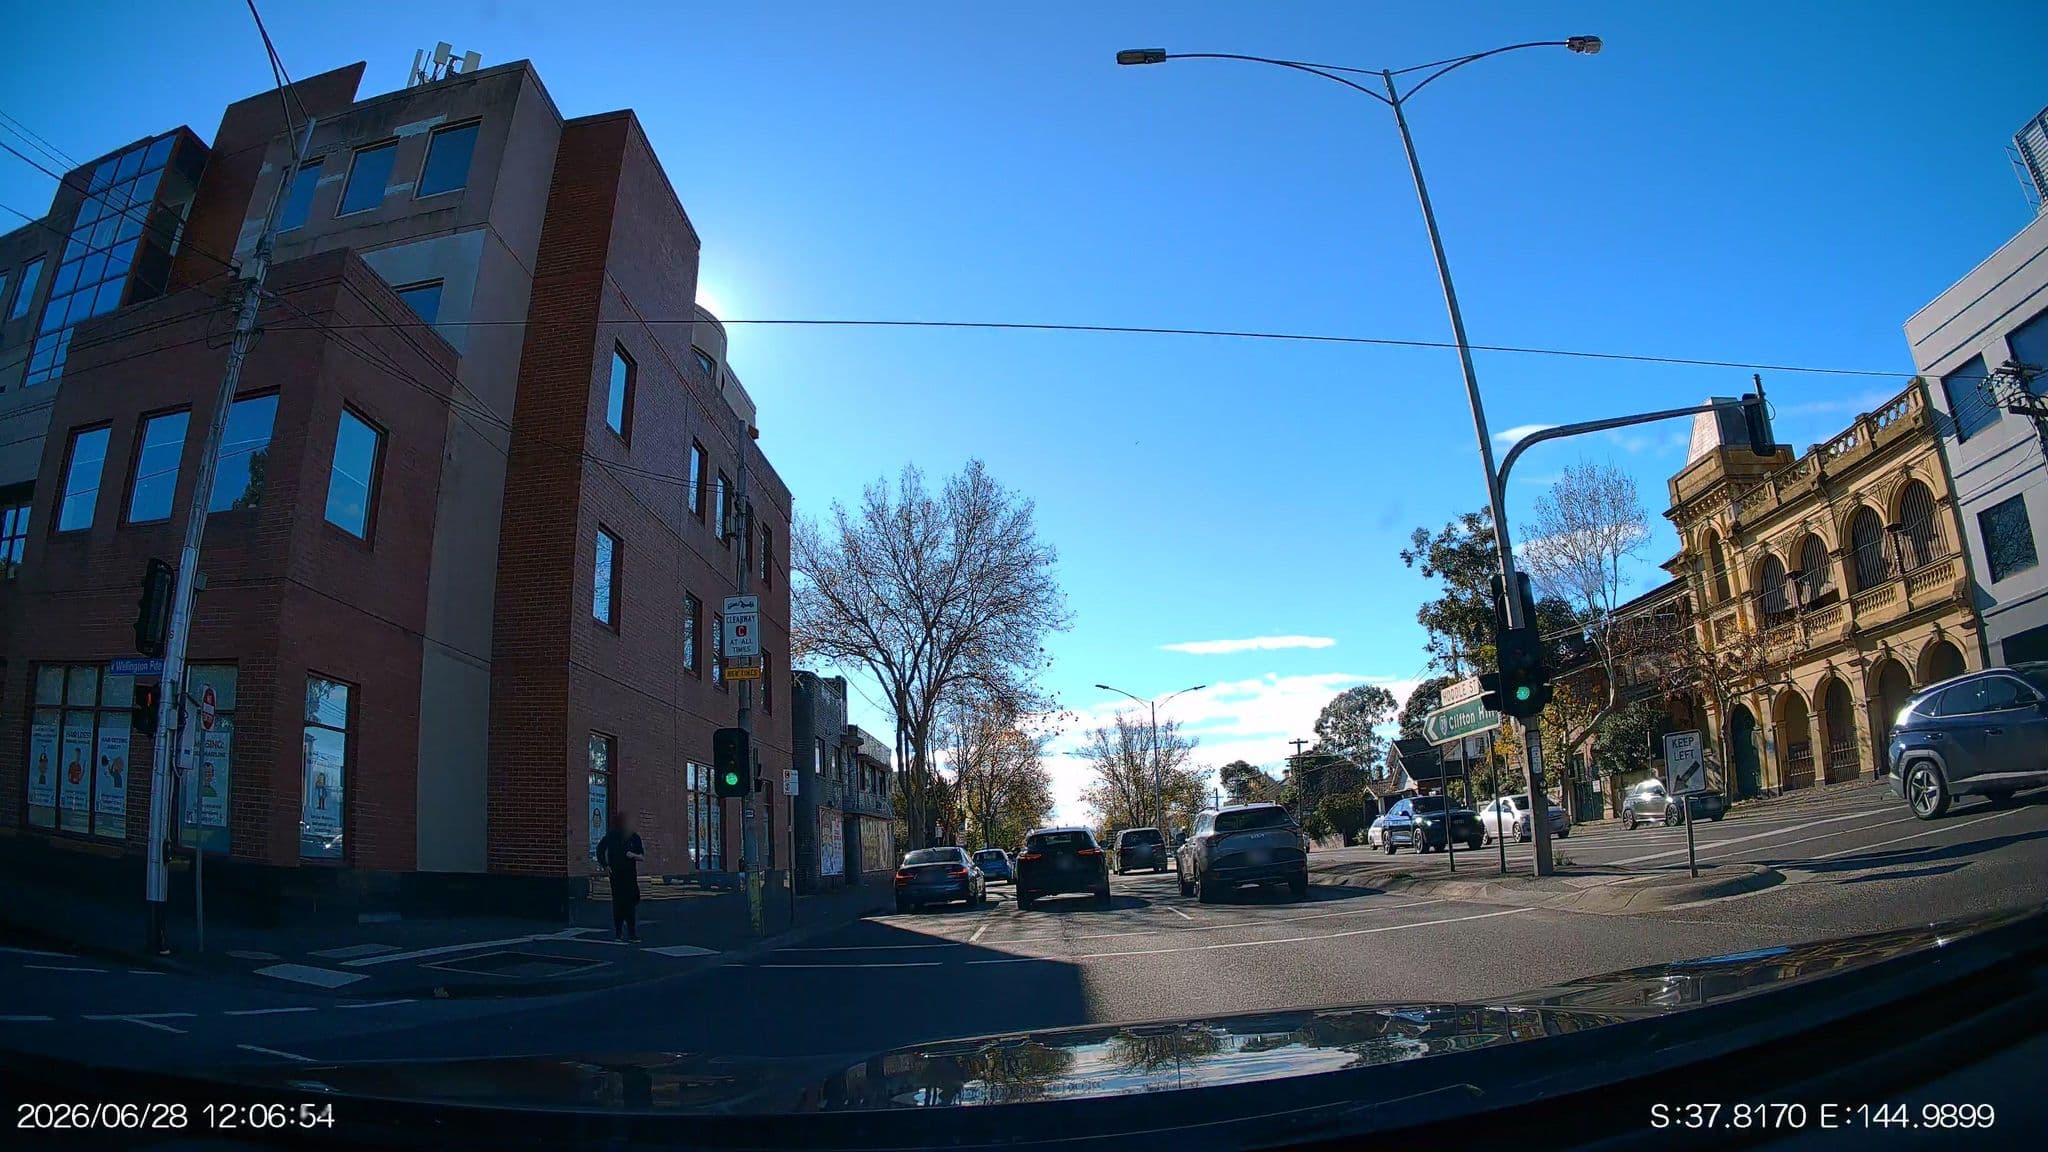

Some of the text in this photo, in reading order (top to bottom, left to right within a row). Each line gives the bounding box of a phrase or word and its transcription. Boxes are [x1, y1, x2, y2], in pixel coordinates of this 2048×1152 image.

[727, 616, 755, 624] CLEARWAY
[1469, 679, 1477, 693] ST
[1449, 713, 1475, 729] Clifton
[1672, 736, 1694, 748] KEEP
[1673, 749, 1694, 761] LEFT
